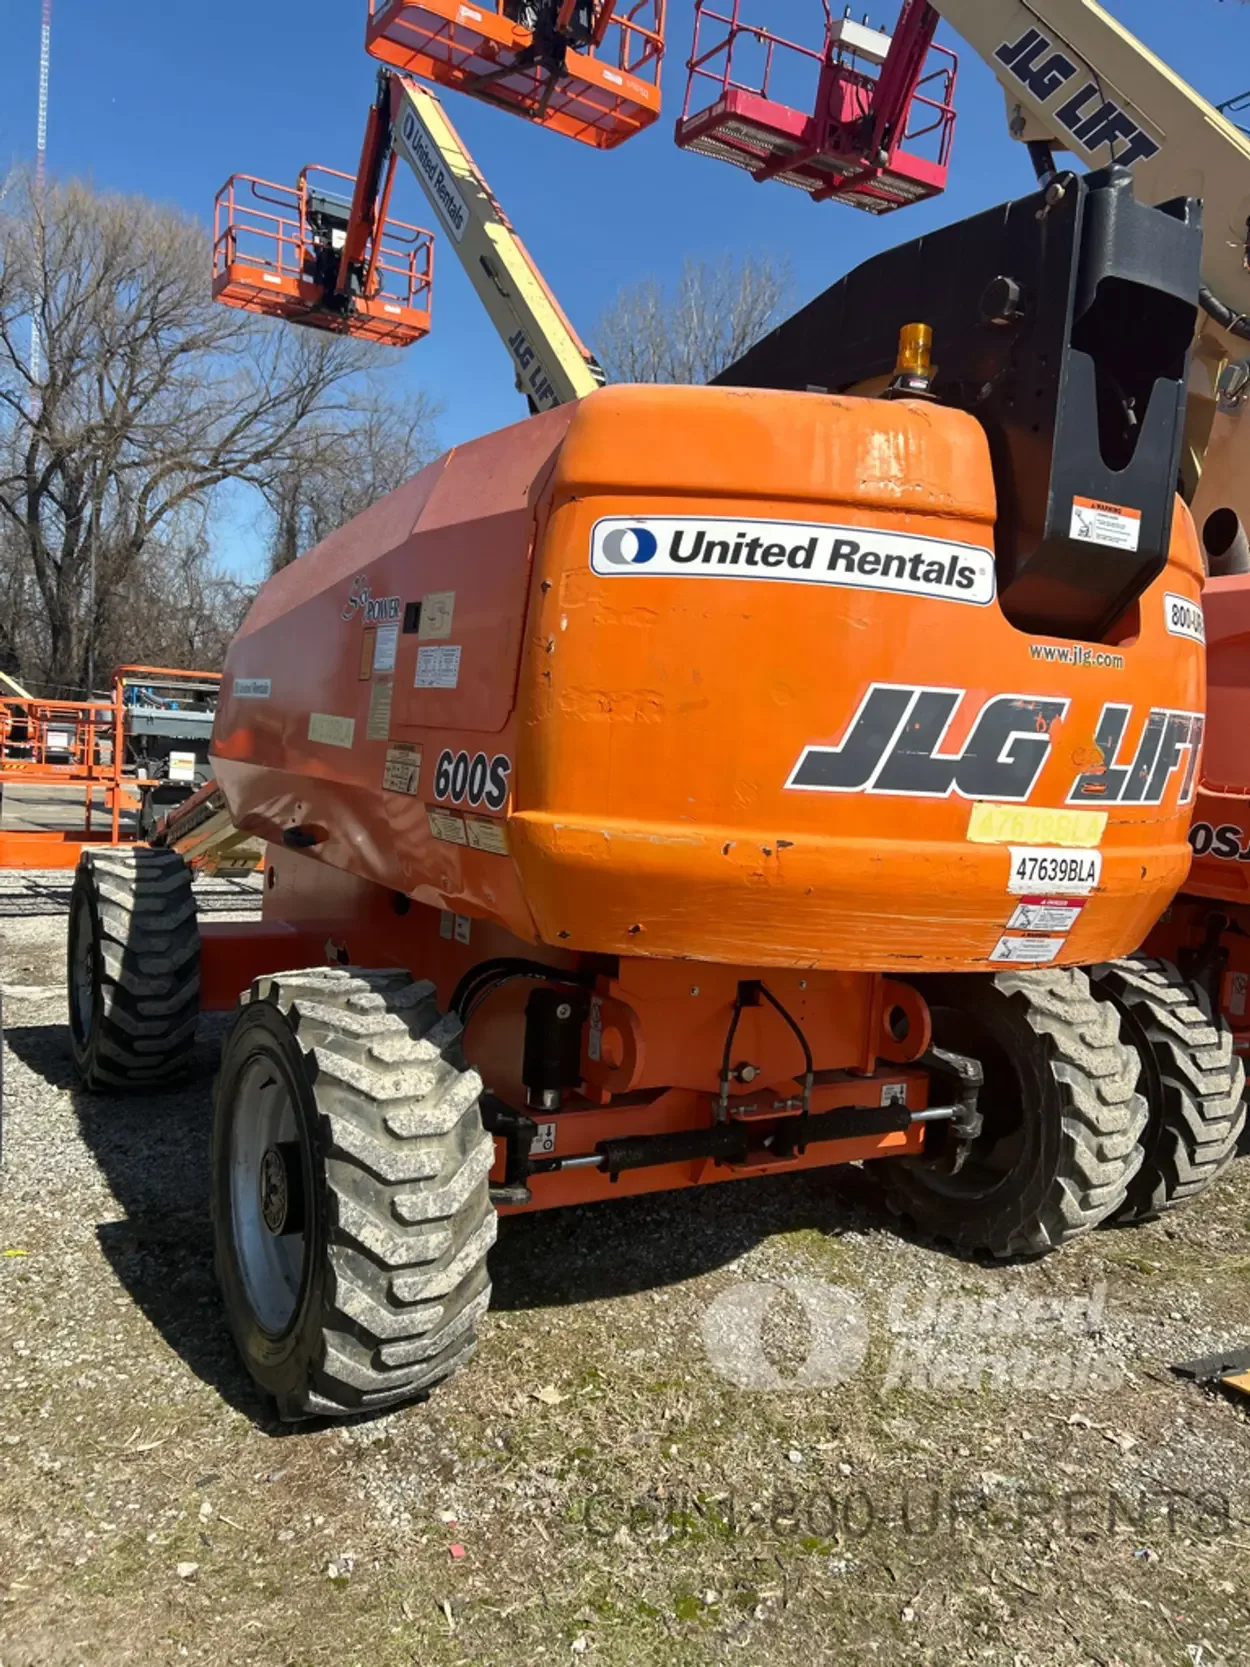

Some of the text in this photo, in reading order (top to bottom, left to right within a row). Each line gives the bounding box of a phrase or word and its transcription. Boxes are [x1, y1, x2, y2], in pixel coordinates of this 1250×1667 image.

[993, 27, 1162, 167] JLG LIFT
[411, 129, 464, 230] United Rentals
[508, 329, 535, 371] JLG
[669, 530, 976, 590] United Rentals
[1029, 645, 1124, 669] www.jlg.com
[783, 682, 1071, 801] JLG
[434, 749, 511, 810] 600S
[1016, 857, 1095, 882] 47639BLA
